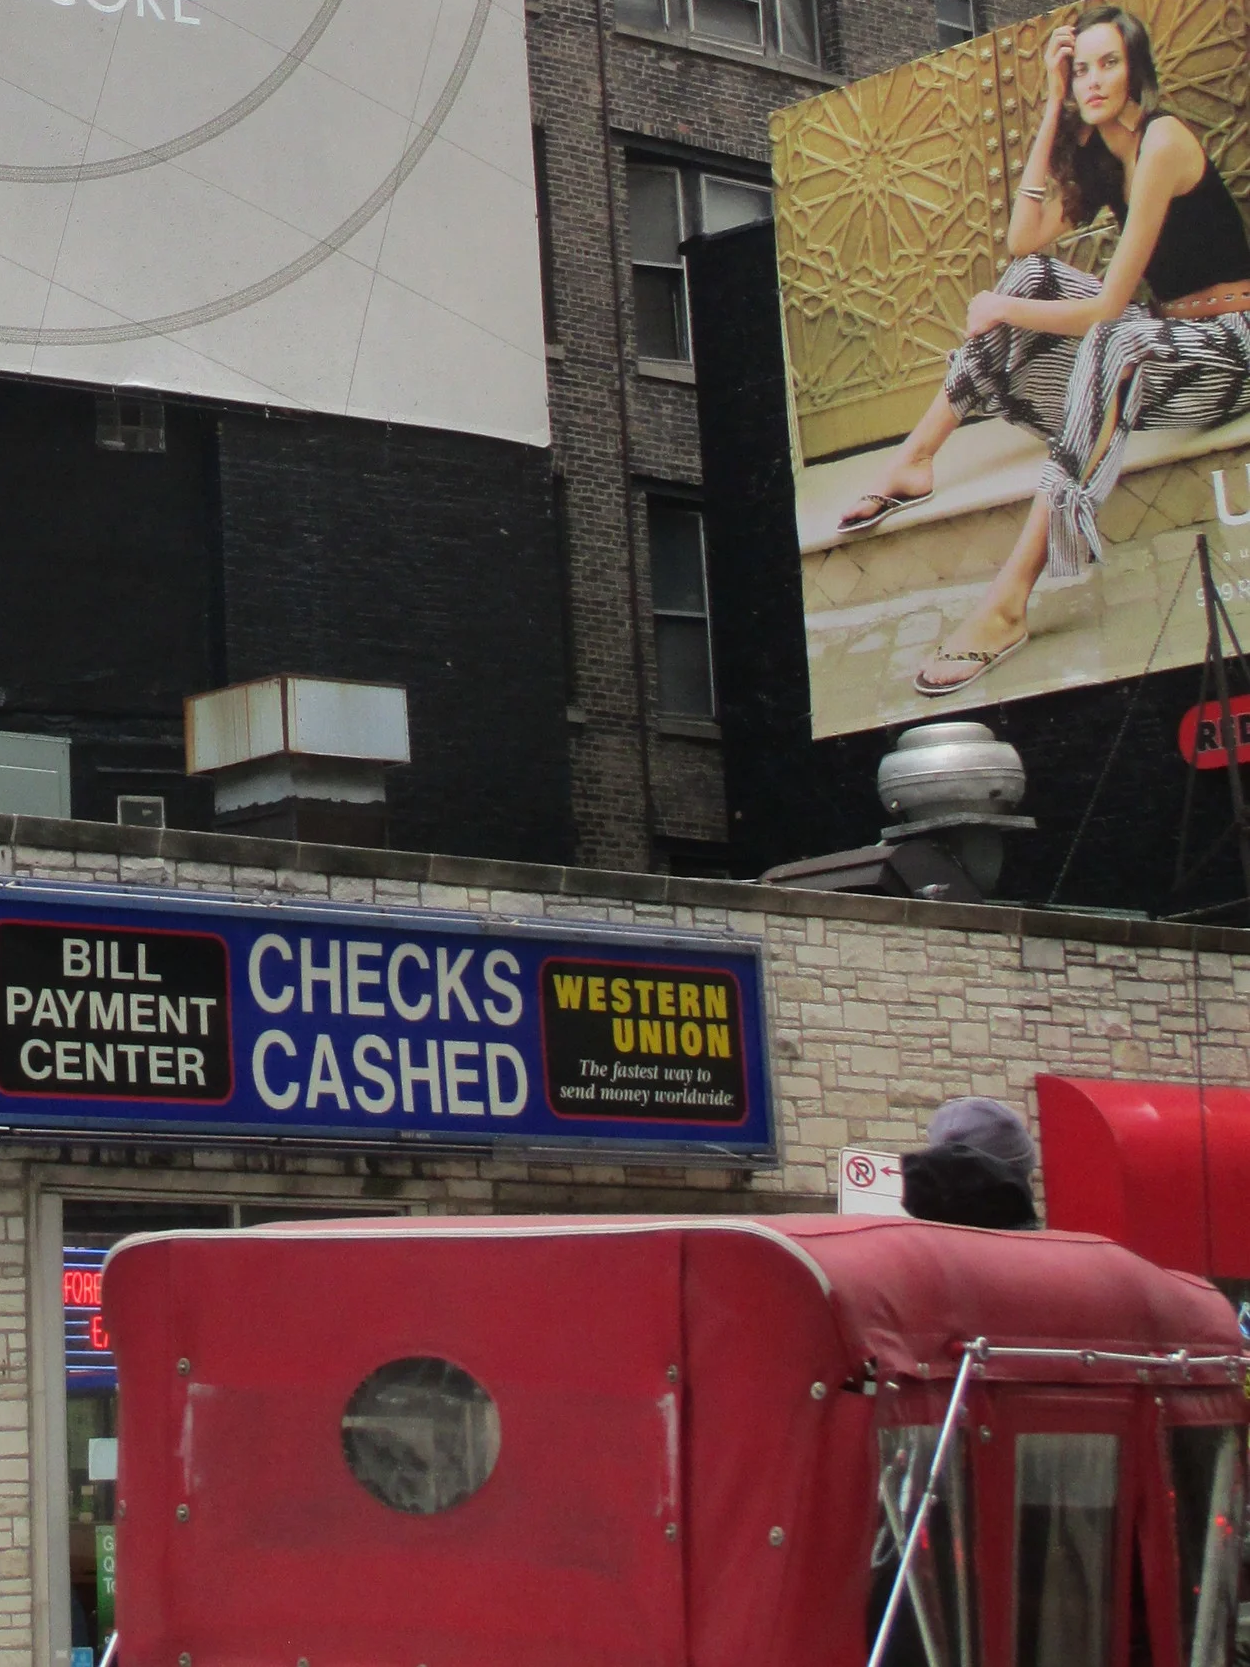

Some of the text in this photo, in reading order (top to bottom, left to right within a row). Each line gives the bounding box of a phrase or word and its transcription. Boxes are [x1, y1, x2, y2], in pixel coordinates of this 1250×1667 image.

[62, 938, 162, 982] BILL
[248, 933, 524, 1026] CHECKS
[5, 986, 217, 1036] PAYMENT
[553, 974, 728, 1019] WESTERN
[612, 1018, 731, 1058] UNION
[19, 1038, 205, 1087] CENTER
[251, 1028, 528, 1116] CASHED
[580, 1059, 711, 1086] The fastest way to
[559, 1084, 735, 1106] send money worldwide.
[64, 1272, 102, 1304] FORE
